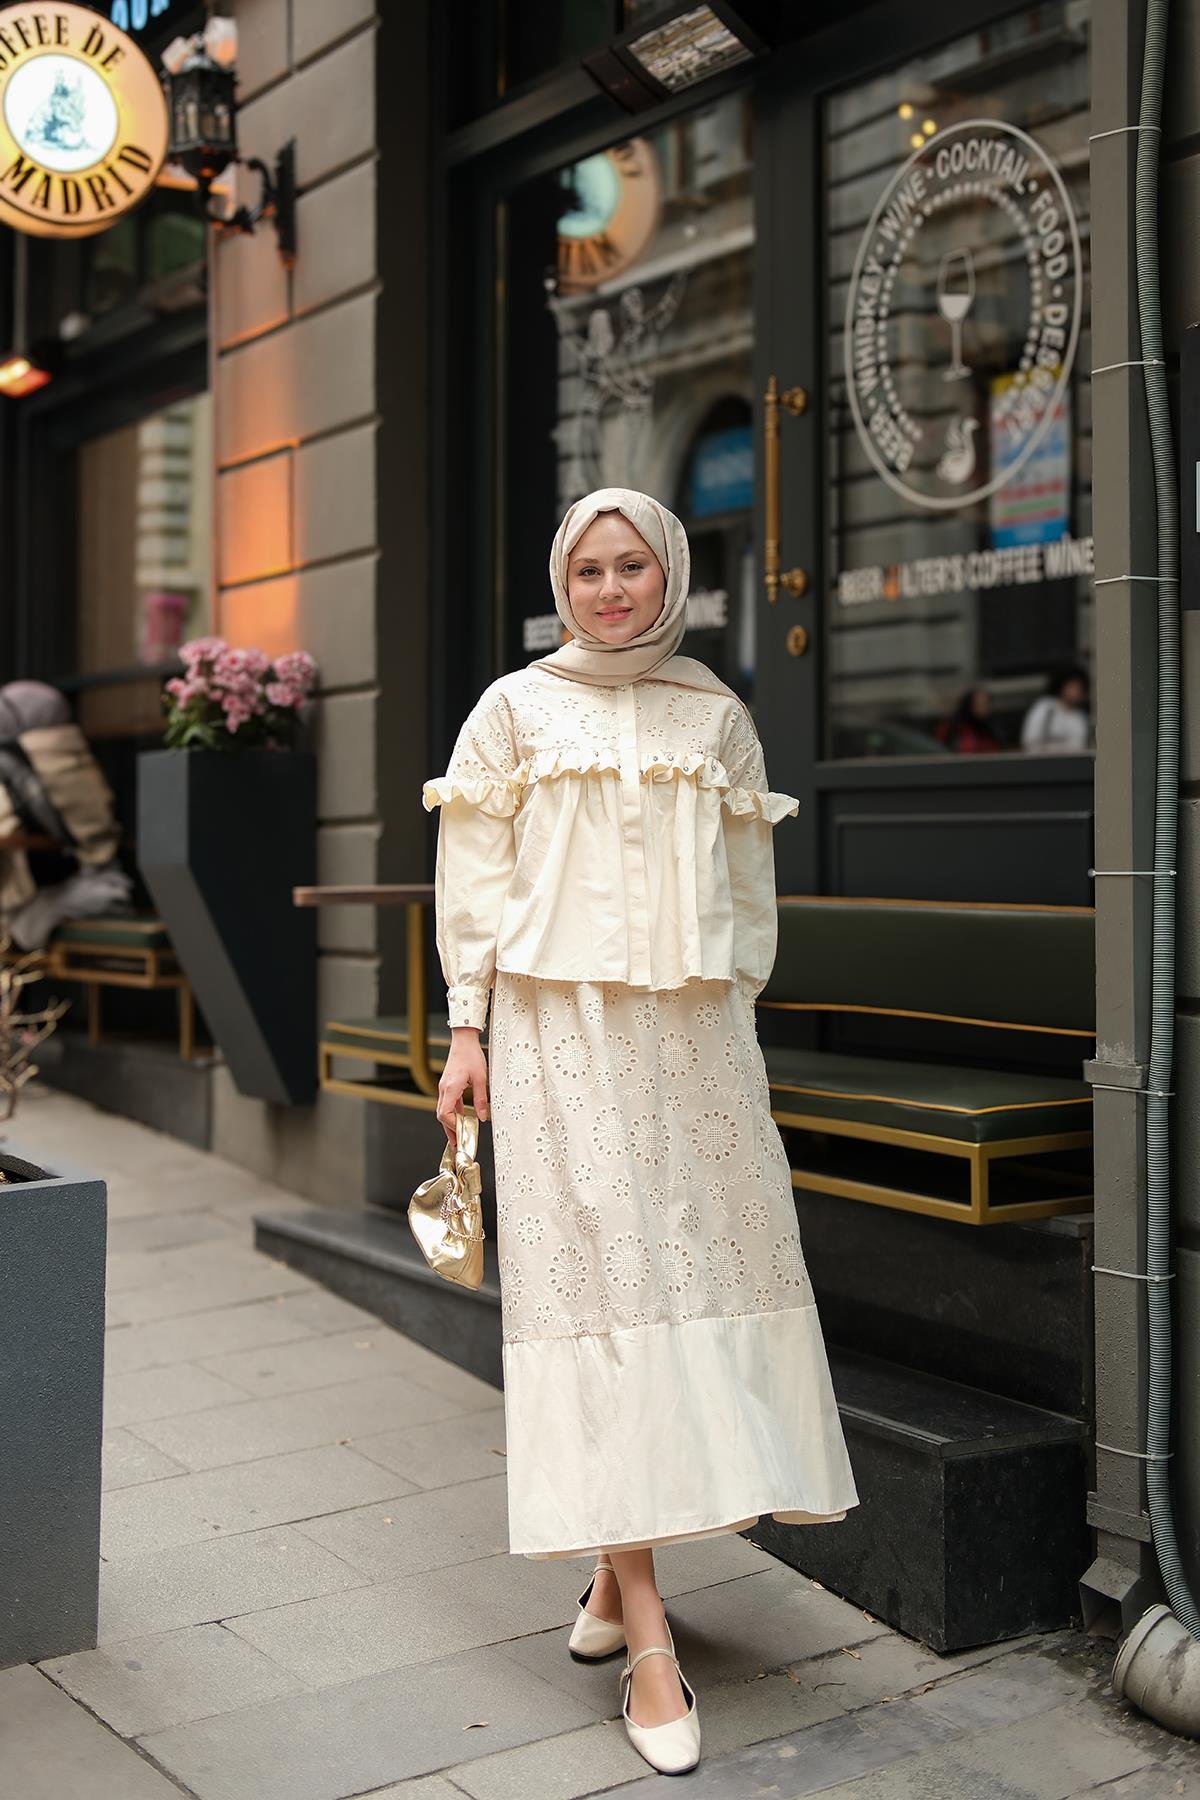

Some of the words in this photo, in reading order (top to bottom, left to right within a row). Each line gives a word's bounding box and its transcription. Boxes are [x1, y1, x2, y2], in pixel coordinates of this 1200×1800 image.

[82, 22, 127, 73] DE
[0, 144, 152, 216] MADRID
[854, 255, 885, 398] WHISKEY
[878, 172, 928, 242] WINE
[936, 138, 1031, 195] COCKTAIL
[1028, 190, 1069, 280] FOOD
[966, 544, 1042, 591] COFFEE
